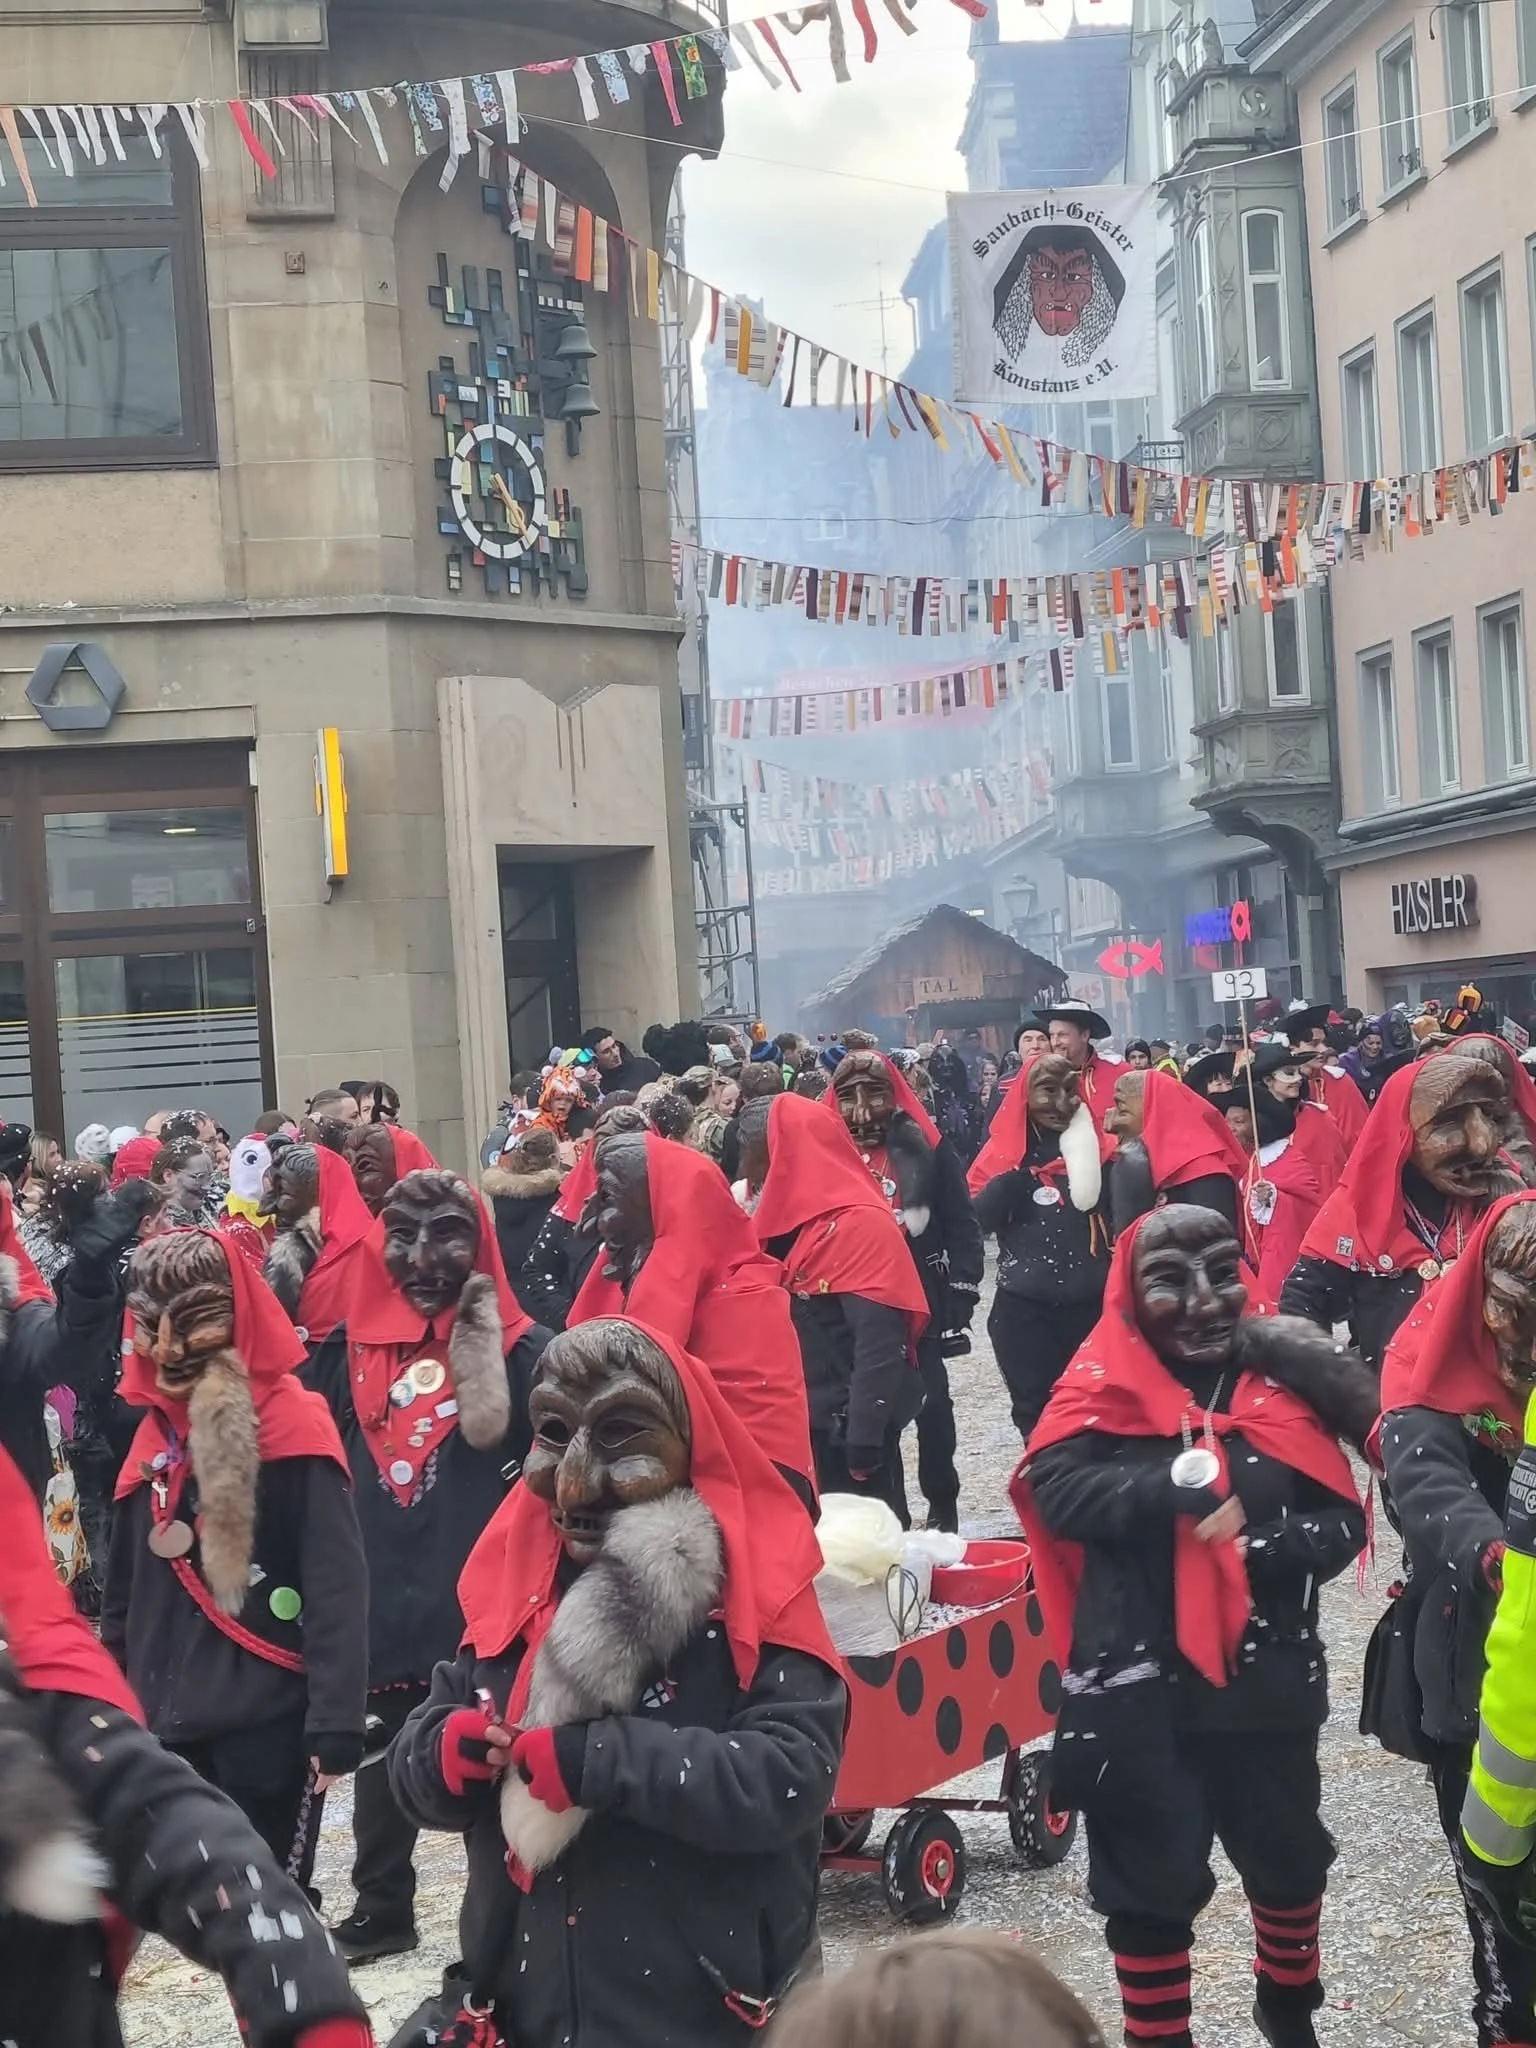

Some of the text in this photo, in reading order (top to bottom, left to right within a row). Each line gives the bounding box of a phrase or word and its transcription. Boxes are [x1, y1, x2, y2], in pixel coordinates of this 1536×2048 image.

[992, 357, 1119, 392] Konstanz e.V.
[1391, 874, 1469, 934] HASLER
[1224, 971, 1255, 999] 93
